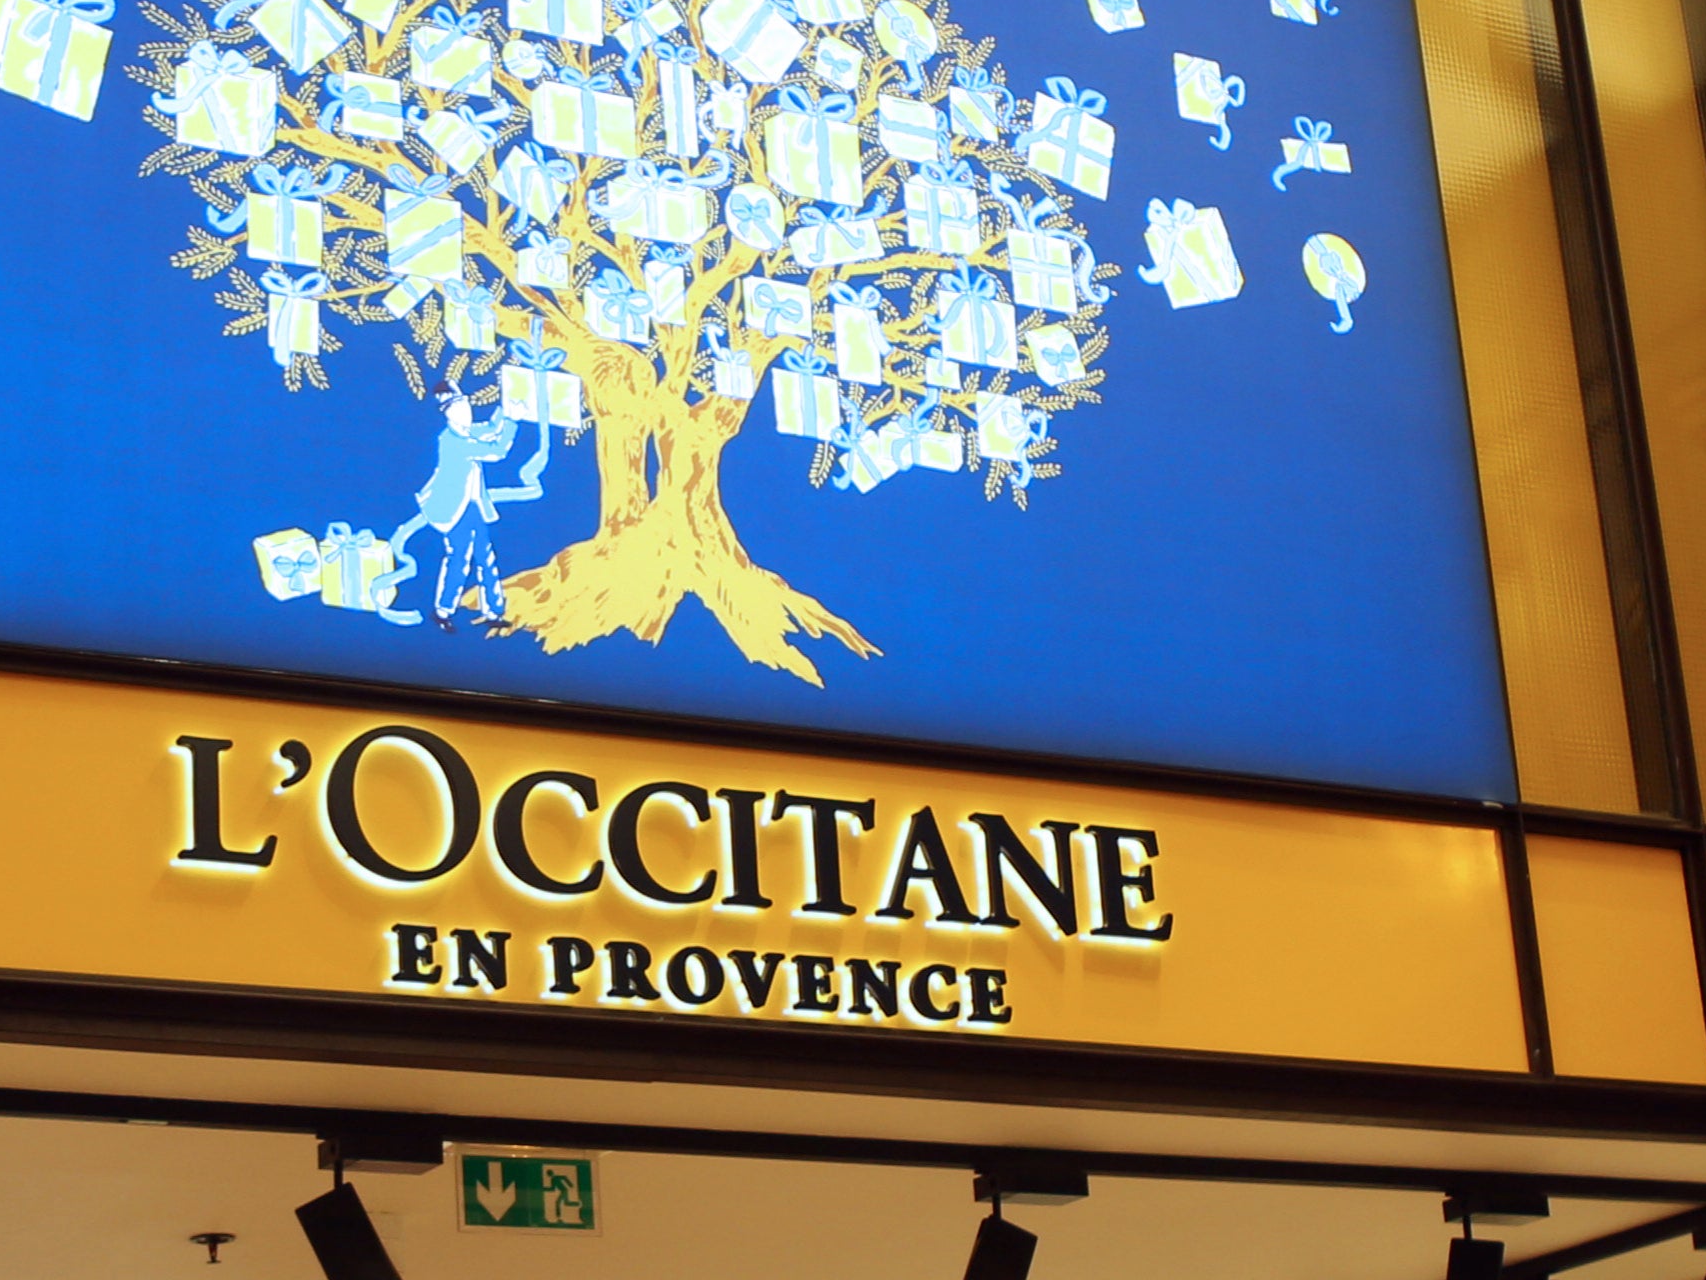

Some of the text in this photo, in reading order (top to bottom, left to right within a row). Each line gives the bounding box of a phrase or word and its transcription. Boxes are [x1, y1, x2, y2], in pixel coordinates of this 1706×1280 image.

[171, 724, 1174, 941] L'OCCITANE
[387, 922, 1012, 1024] EN PROVENCE
